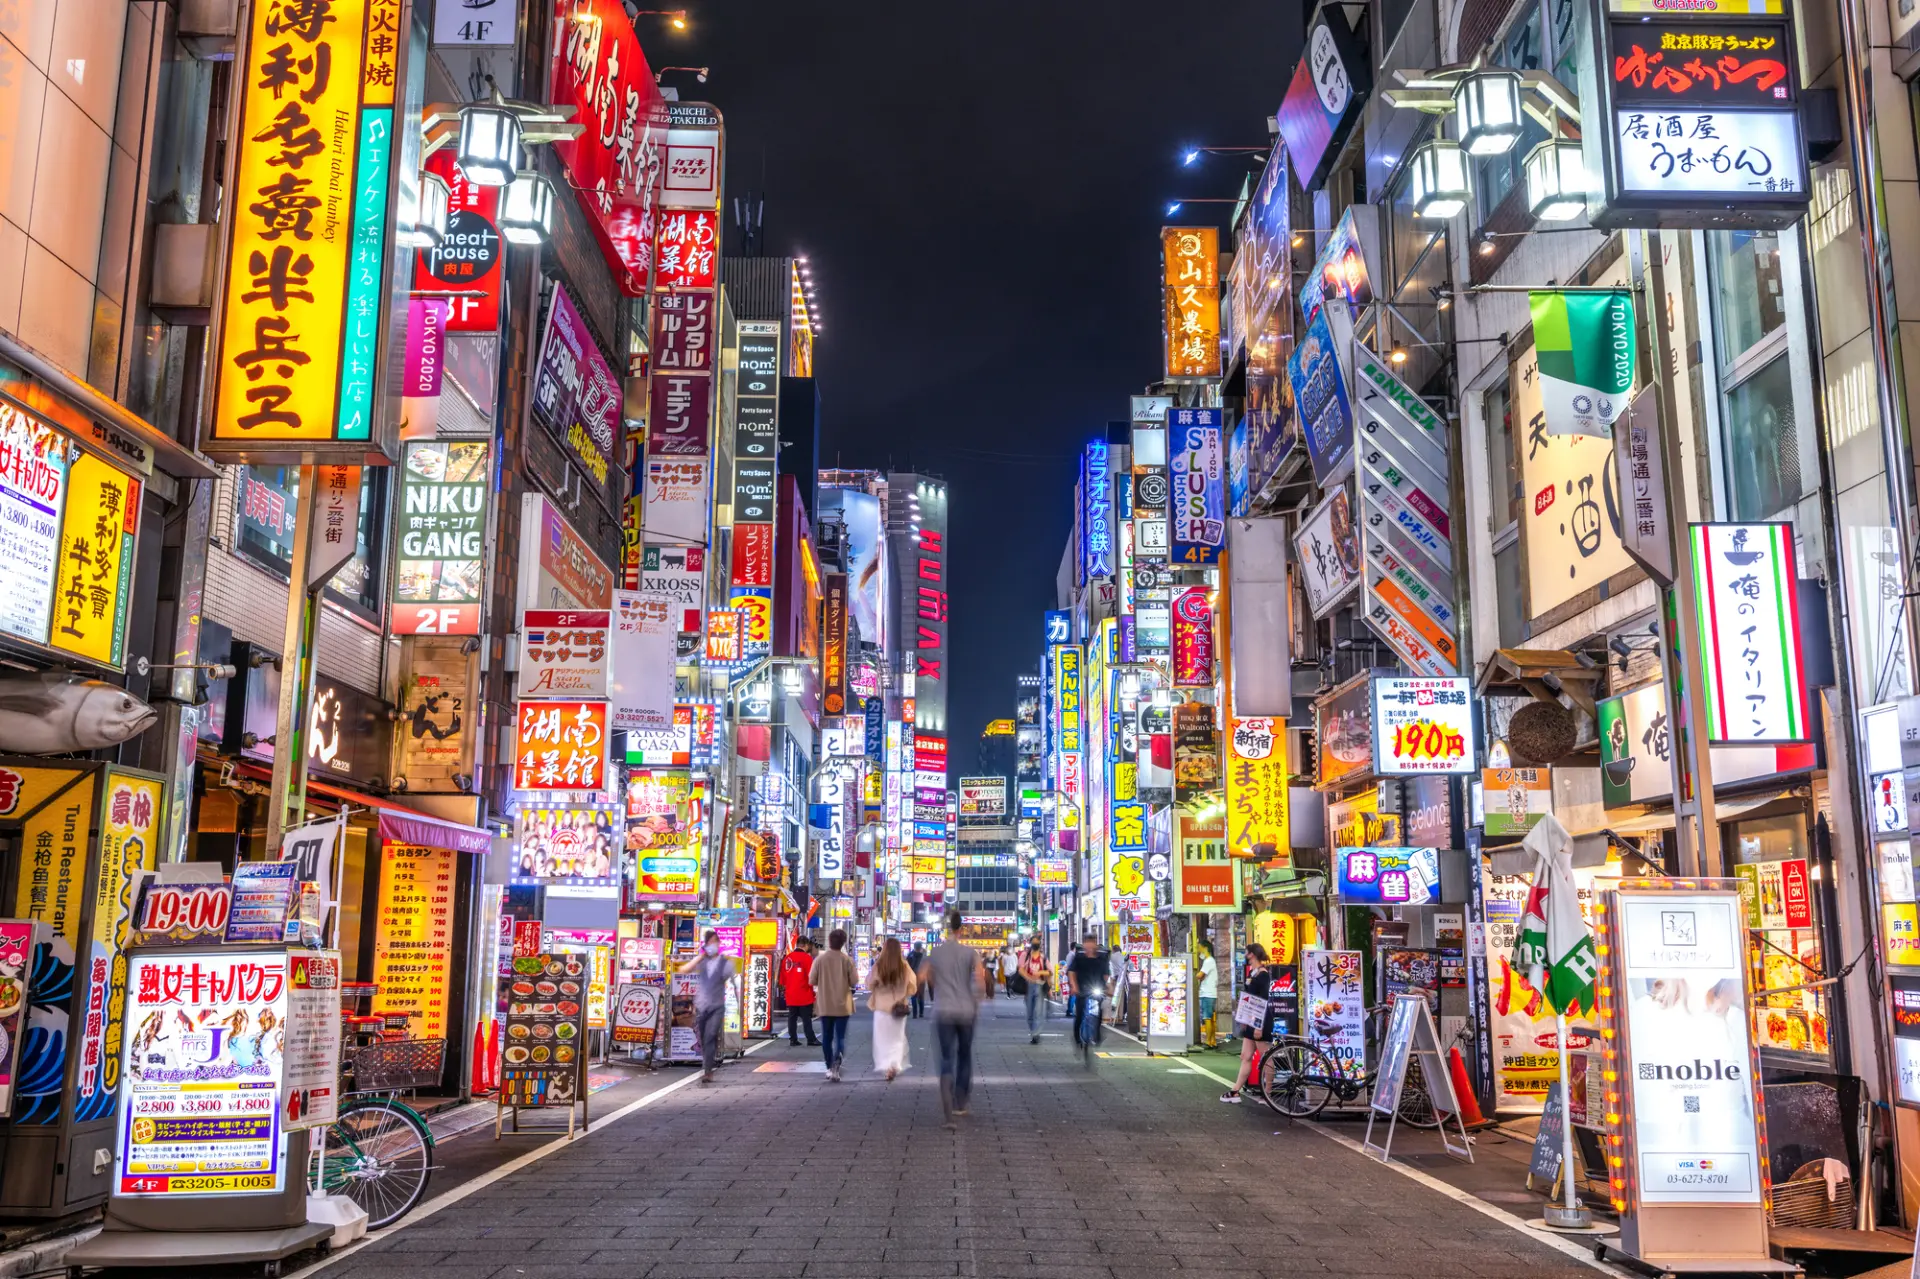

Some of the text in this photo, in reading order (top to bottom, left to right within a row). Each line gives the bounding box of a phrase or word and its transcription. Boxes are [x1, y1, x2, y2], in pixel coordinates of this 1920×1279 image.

[457, 20, 493, 41] 4F
[1661, 32, 1776, 50] 東京豚骨ラーメン
[669, 107, 706, 116] DAIICHI
[697, 117, 718, 125] BLD
[1622, 113, 1720, 140] 居酒屋
[1650, 141, 1772, 178] うまいもん
[321, 109, 349, 243] Hakuri tabai hanbey
[1747, 176, 1795, 192] 一番街
[444, 229, 498, 245] meat
[659, 213, 714, 245] 湖南
[443, 262, 474, 276] 肉屋
[658, 245, 713, 276] 菜館
[662, 297, 681, 308] 3F
[1178, 259, 1205, 361] 山久農場
[685, 296, 706, 368] レンタル
[740, 325, 778, 333] 第一桑原ビル
[661, 314, 680, 367] ルーム
[1611, 302, 1630, 387] TOKYO 2020
[417, 307, 438, 392] TOKYO 2020
[1184, 365, 1203, 374] 5F
[539, 372, 558, 411] 3F
[1364, 389, 1378, 401] 7
[581, 377, 618, 452] Eden
[664, 379, 691, 433] エデン
[1178, 409, 1212, 424] 麻雀
[1366, 421, 1379, 434] 6
[661, 436, 703, 453] Eden
[1367, 451, 1381, 464] 5
[663, 463, 702, 475] タイ古式
[739, 469, 771, 477] Party Space
[650, 475, 702, 485] マッサージ
[1368, 483, 1382, 494] 4
[1631, 426, 1655, 537] 劇場通り一番街
[405, 486, 483, 514] NIKU
[1087, 439, 1112, 577] カラオケの鉄人
[1176, 476, 1188, 540] エスラッシュ
[410, 516, 475, 529] 肉ギャング
[1369, 513, 1383, 527] 3
[1397, 511, 1437, 550] センチュリー
[87, 480, 123, 620] 薄利多賣
[403, 532, 481, 557] GANG
[1370, 544, 1384, 559] 2
[744, 524, 758, 585] リフレッシュ
[760, 525, 769, 583] レンタルルーム ホステル
[1185, 547, 1211, 563] 4F
[1382, 554, 1400, 571] TV
[643, 577, 700, 591] XROSS
[1173, 587, 1184, 595] 3F
[632, 600, 668, 612] タイ古式
[917, 529, 948, 680] HUMAX
[415, 608, 461, 633] 2F
[558, 615, 577, 625] 2F
[619, 610, 668, 622] マッサージ
[1371, 605, 1390, 624] B1
[620, 623, 633, 631] 2F
[546, 629, 605, 646] タイ古式
[749, 641, 769, 650] 天神
[829, 588, 842, 687] 個室ダイニング居酒屋
[527, 648, 604, 663] マッサージ
[1183, 623, 1195, 678] カリーナ
[1728, 573, 1767, 737] 俺のイタリアン
[553, 682, 592, 690] Relax
[453, 698, 462, 711] 2
[1061, 652, 1081, 750] まんが喫茶
[1382, 688, 1466, 706] 一軒め酒場
[523, 703, 601, 749] 湖南
[868, 700, 881, 751] カラオケ
[1179, 723, 1211, 731] Walton's
[1906, 728, 1918, 740] 5F
[637, 738, 680, 751] CASA
[1235, 729, 1271, 750] 新宿
[1393, 723, 1465, 758] 190円
[1247, 746, 1260, 758] の
[520, 752, 537, 786] 4F
[538, 750, 599, 787] 菜館
[1234, 760, 1263, 847] まっちゃん
[1190, 823, 1223, 831] OPEN 24h
[652, 833, 682, 844] 1000
[112, 836, 123, 865] Tuna
[914, 860, 933, 870] ゲーム
[1379, 857, 1408, 867] フリー
[1887, 854, 1910, 865] noble
[29, 830, 54, 919] 金枪鱼餐厅
[52, 804, 80, 938] Tuna Restaurant
[1350, 852, 1409, 900] 麻雀
[657, 882, 694, 892] 受付3F
[1186, 885, 1230, 893] ONLINE CAFE
[1791, 887, 1802, 897] OK
[1204, 895, 1213, 903] B1
[143, 890, 228, 929] 19:00
[1893, 920, 1912, 932] 麻雀
[1271, 919, 1287, 964] 鉄なべ餃子
[1889, 937, 1920, 949] クアトロ
[1339, 955, 1357, 969] 3F
[137, 962, 285, 1004] 熟女キャバクラ
[752, 957, 769, 1027] 無料案内所
[615, 1032, 653, 1042] COFFEE
[1655, 1058, 1741, 1082] noble
[130, 1176, 272, 1190] 4F 3205-1005
[1667, 1173, 1729, 1184] 03-6273-8701
